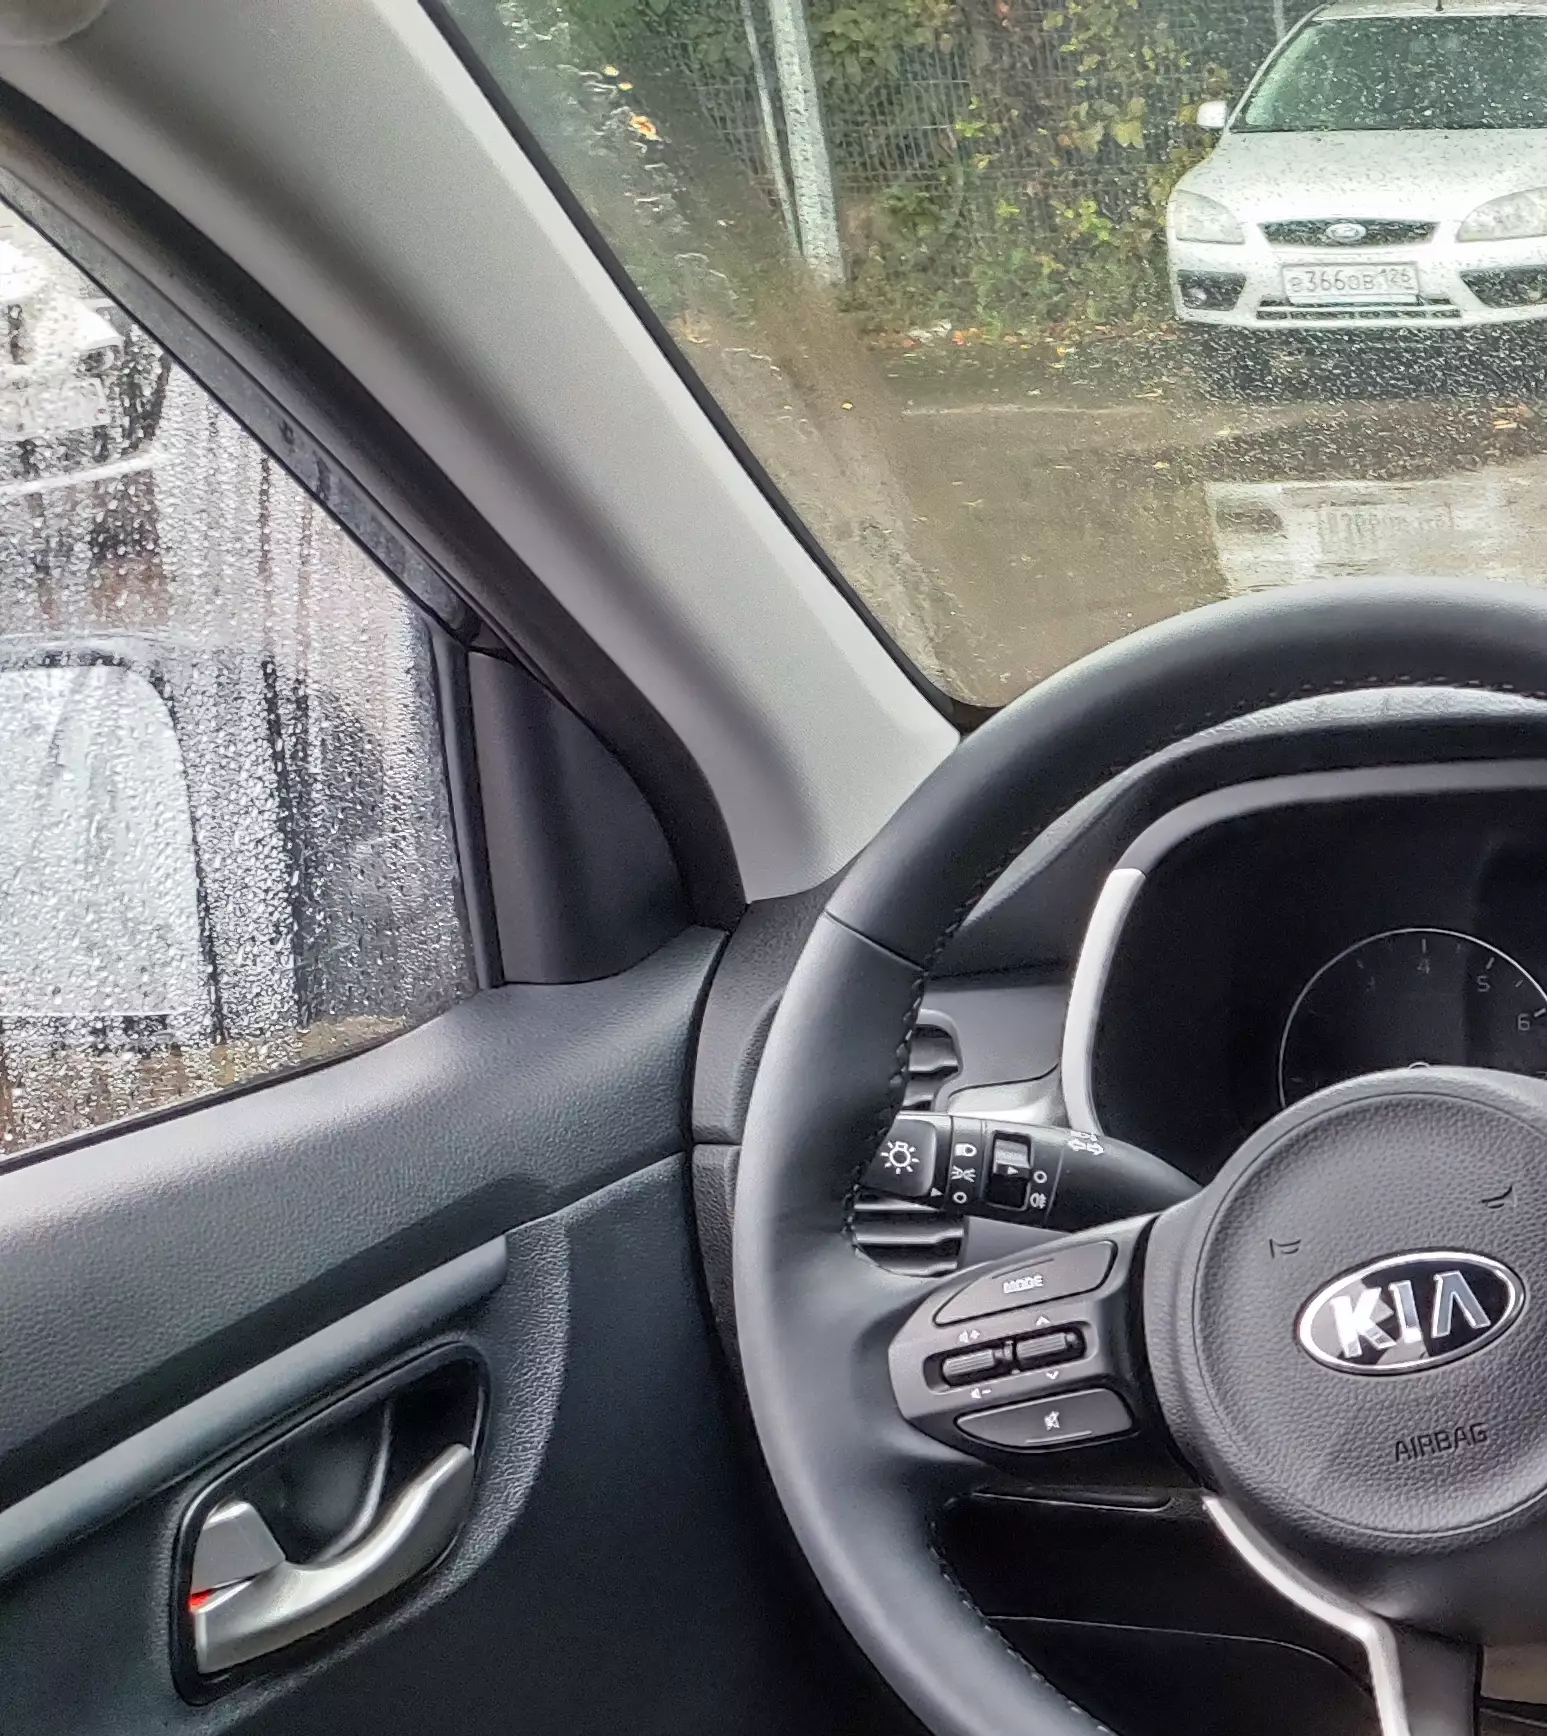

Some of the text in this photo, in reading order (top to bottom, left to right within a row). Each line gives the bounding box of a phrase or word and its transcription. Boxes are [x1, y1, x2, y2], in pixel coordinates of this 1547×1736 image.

[1476, 975, 1491, 993] 5
[1517, 1012, 1531, 1031] 6
[1328, 1269, 1492, 1359] KIA
[1395, 1422, 1488, 1462] AIRBAG
